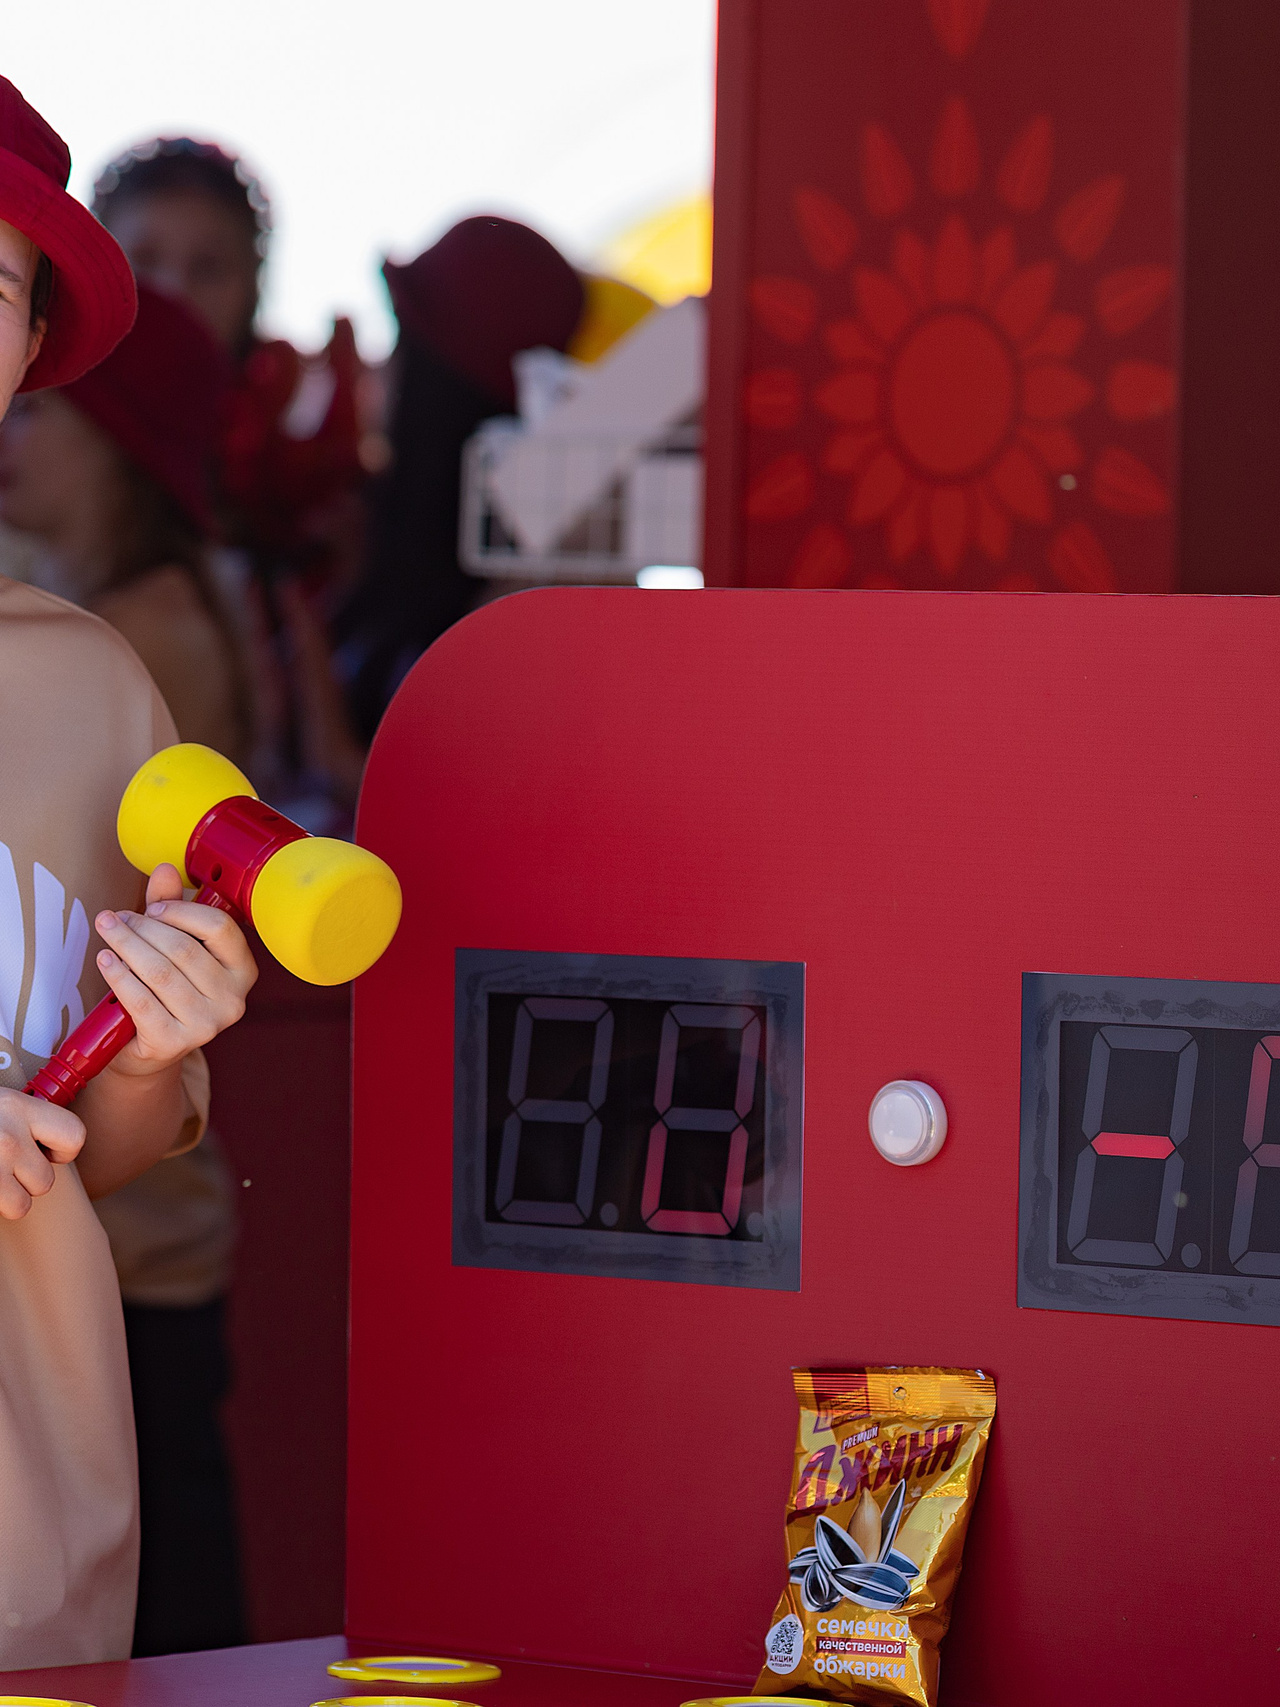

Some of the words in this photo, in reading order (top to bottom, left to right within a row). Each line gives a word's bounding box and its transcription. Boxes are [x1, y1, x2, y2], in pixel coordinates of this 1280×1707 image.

[842, 1425, 879, 1451] PREMIUM
[816, 1618, 909, 1638] семечки
[818, 1640, 903, 1655] качественной
[813, 1655, 907, 1680] обжарки
